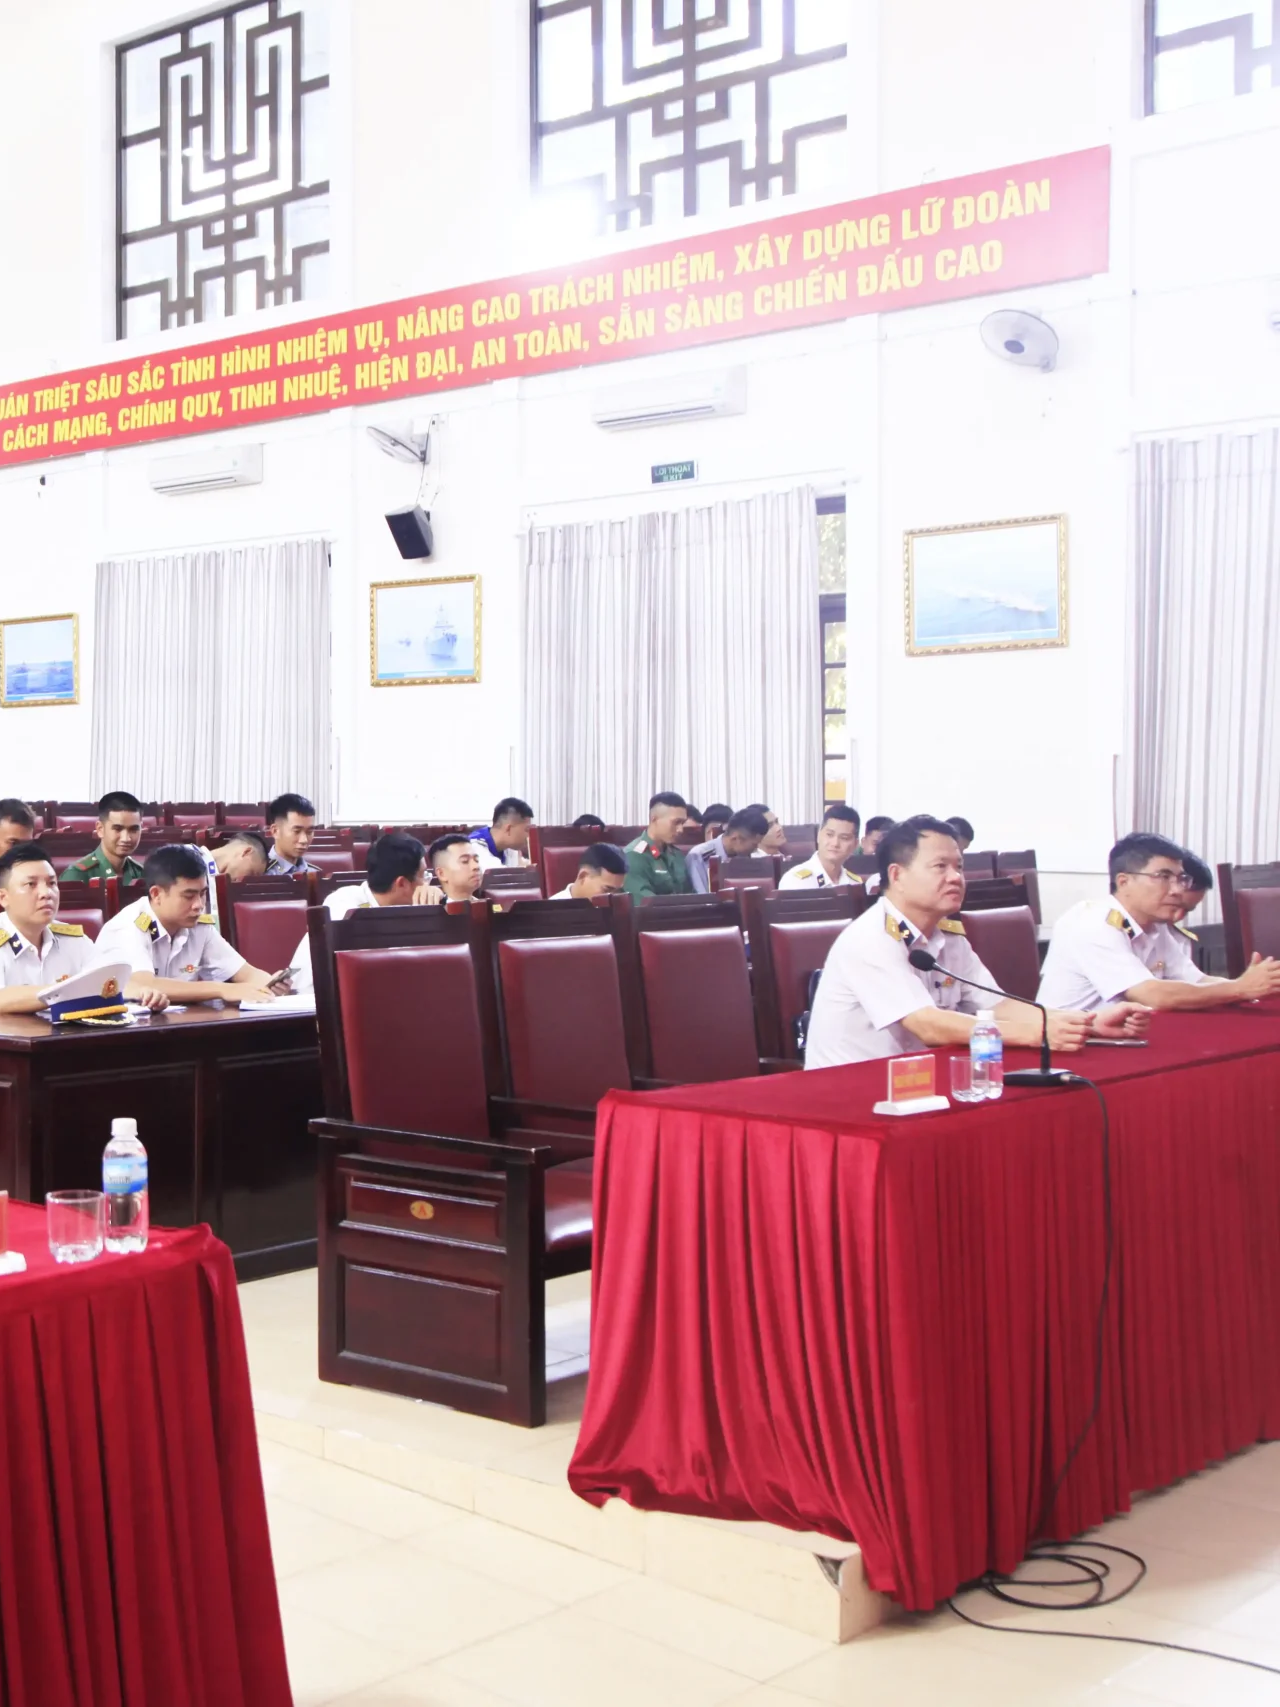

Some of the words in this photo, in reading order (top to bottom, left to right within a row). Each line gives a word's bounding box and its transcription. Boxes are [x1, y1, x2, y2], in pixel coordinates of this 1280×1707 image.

[3, 419, 48, 452] CÁCH
[53, 412, 112, 444] MẠNG,
[118, 399, 176, 431] CHÍNH
[182, 390, 223, 421] QUY,
[229, 380, 277, 412] TINH
[283, 363, 348, 403] NHUỆ,
[355, 353, 409, 391] HIỆN
[416, 346, 464, 381] ĐẠI,
[471, 337, 506, 369] AN
[513, 321, 589, 361] TOÀN,
[598, 302, 655, 345] SẴN
[664, 291, 744, 333] SÀNG
[754, 264, 847, 316] CHIẾN
[856, 247, 923, 297] ĐẤU
[935, 239, 1003, 281] CAO
[33, 381, 81, 412] TRIỆT
[85, 373, 122, 403] SÂU
[127, 360, 165, 395] SẮC
[170, 355, 215, 387] TÌNH
[221, 343, 271, 377] HÌNH
[276, 327, 347, 366] NHIỆM
[354, 320, 390, 352] VỤ,
[397, 306, 464, 342] NÂNG
[472, 293, 520, 327] CAO
[528, 273, 614, 316] TRÁCH
[623, 251, 724, 298] NHIỆM,
[733, 233, 793, 275] XÂY
[802, 213, 890, 261] DỰNG
[902, 196, 946, 240] LỮ
[952, 178, 1050, 230] ĐOÀN
